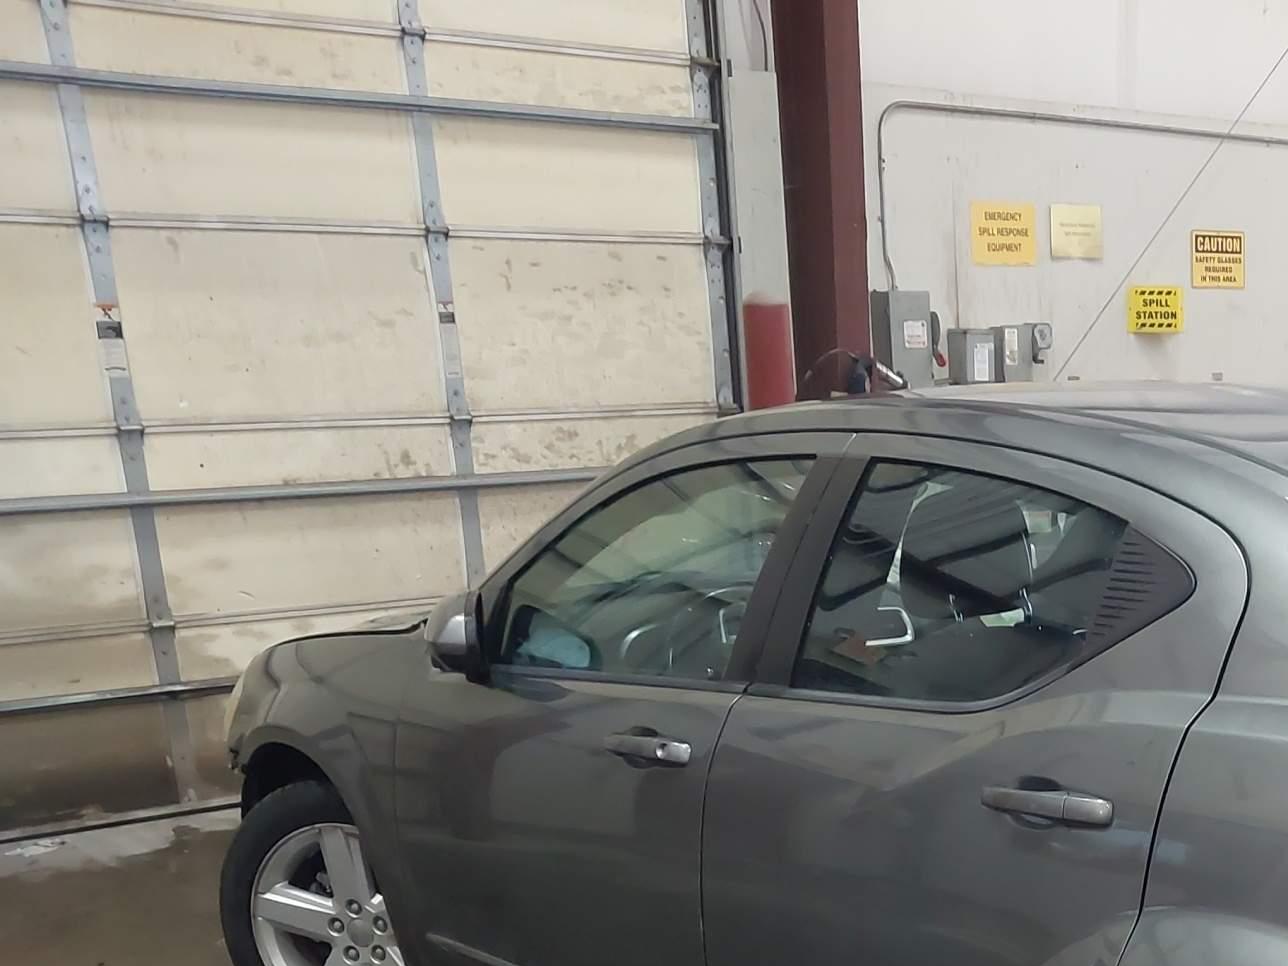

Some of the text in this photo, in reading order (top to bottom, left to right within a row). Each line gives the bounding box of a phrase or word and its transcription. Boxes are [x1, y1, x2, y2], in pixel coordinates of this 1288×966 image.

[984, 211, 1022, 221] EMERGENCY
[978, 226, 1029, 237] SPILL RESPONSE
[987, 242, 1021, 252] EQUIPMENT
[1197, 236, 1241, 252] CAUTION
[1142, 298, 1170, 308] SPILL
[1135, 310, 1177, 320] STATION
